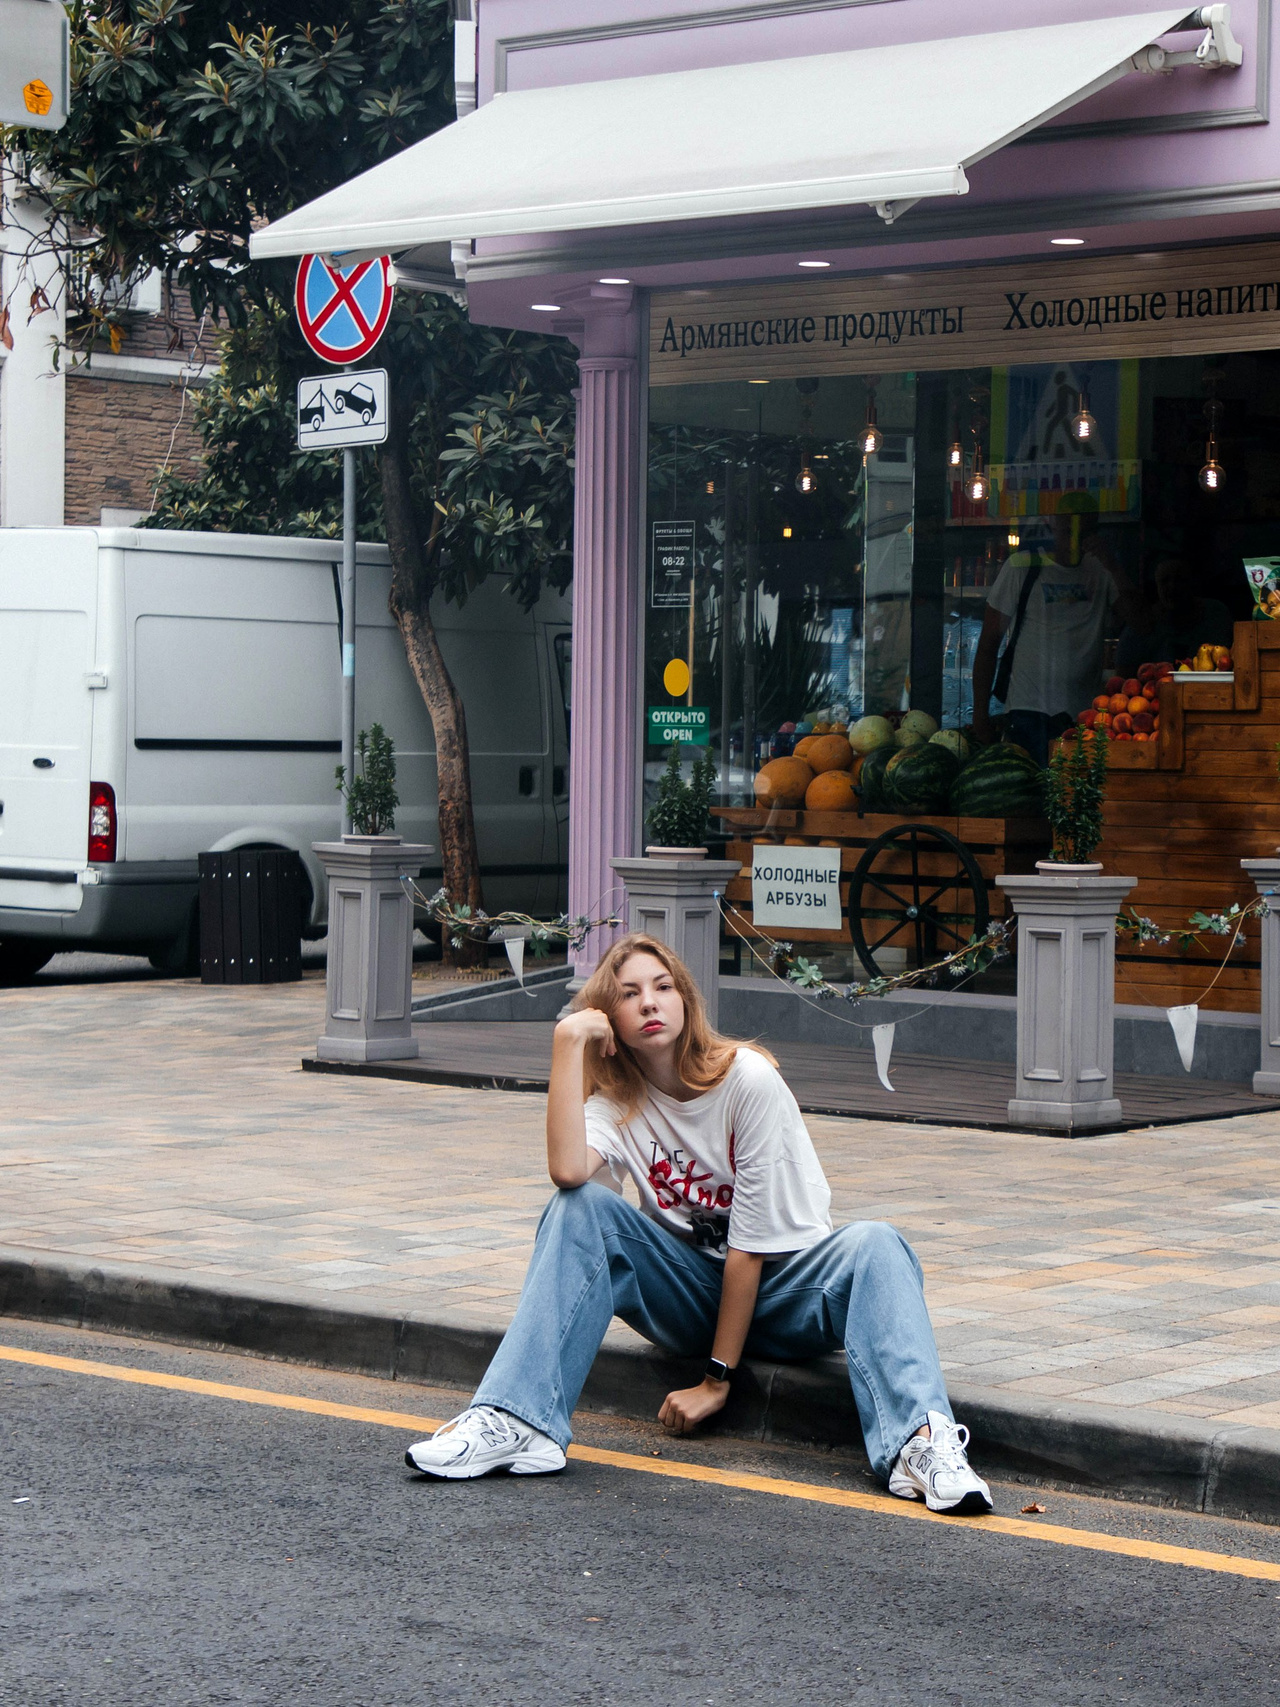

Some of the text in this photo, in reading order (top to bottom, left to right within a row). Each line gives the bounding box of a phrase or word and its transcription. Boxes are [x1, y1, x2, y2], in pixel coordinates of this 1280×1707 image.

[658, 316, 816, 357] Армянские
[823, 306, 966, 347] продукты
[1003, 292, 1167, 332] Холодные
[662, 556, 685, 566] 08-22
[652, 711, 706, 723] ОТКРЫТО
[663, 729, 693, 741] OPEN
[754, 867, 837, 885] ХОЛОДНЫЕ
[766, 891, 826, 907] АРБУЗЫ
